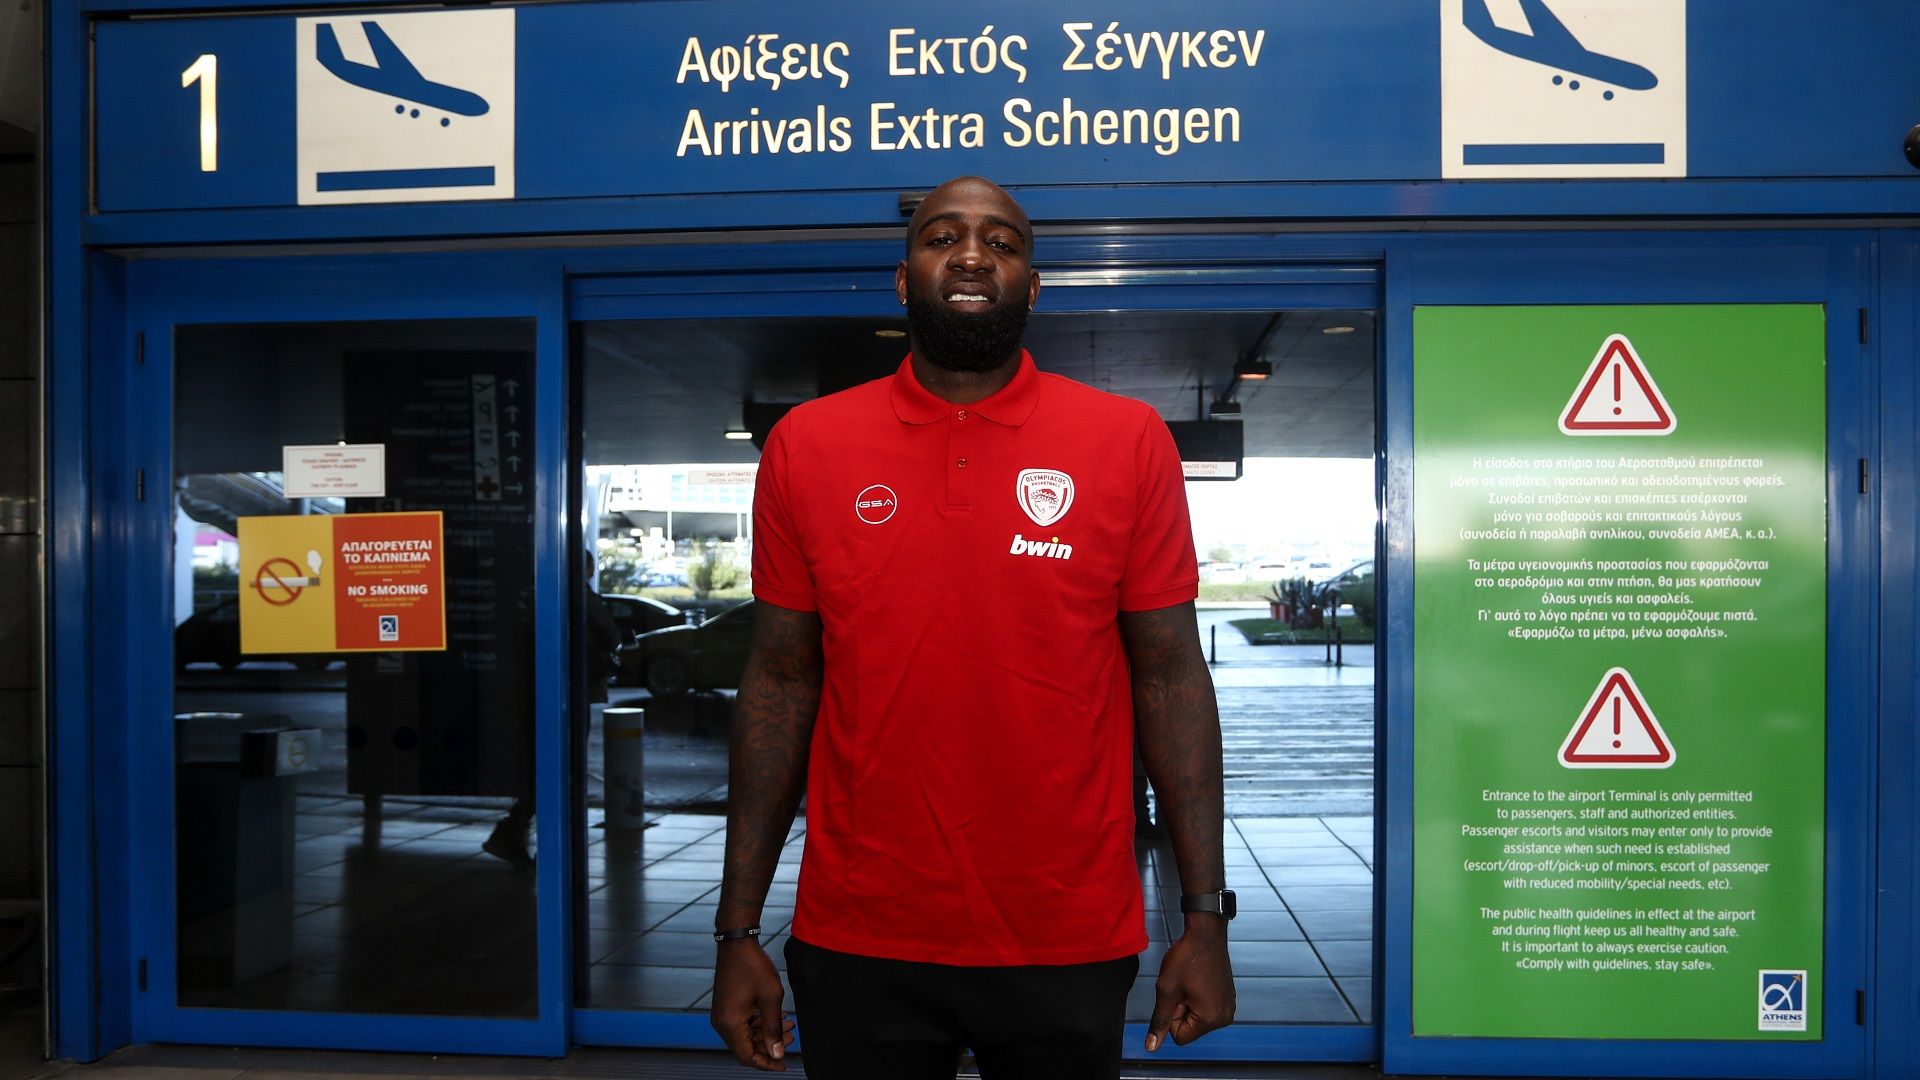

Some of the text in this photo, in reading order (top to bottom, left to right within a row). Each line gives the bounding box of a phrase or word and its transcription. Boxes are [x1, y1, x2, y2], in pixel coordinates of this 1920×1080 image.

[676, 22, 1266, 92] Αφίξεις Εκτός Σένγκεν
[181, 53, 217, 172] 1
[676, 98, 1241, 156] Arrivals Extra Schengen
[1025, 475, 1066, 485] OLYMPIACOS
[859, 498, 894, 509] GSA
[1489, 492, 1747, 506] Συνοδοί επιβατών και επισκέπτες εισέρχονται
[1494, 510, 1742, 524] μόνο για σοβαρούς και επιτακτικούς λόγους
[1460, 528, 1516, 539] (συνοδεία
[1520, 528, 1526, 539] ή
[1530, 528, 1586, 541] παραλαβή
[1590, 528, 1645, 539] ανηλίκου,
[1649, 528, 1701, 539] συνοδεία
[1705, 528, 1742, 539] ΑΜΕΑ,
[341, 540, 433, 552] ΑΠΑΓΟΡΕΥΕΤΑΙ
[1009, 534, 1073, 560] bwin
[343, 551, 431, 563] ΤΟ ΚΑΠΝΙΣΜΑ
[1468, 559, 1768, 572] Τα μέτρα υγειονομικής προστασίας που εφαρμόζονται
[1475, 575, 1761, 589] στο αεροδρόμιο και στην πτήση, θα μας κρατήσουν
[347, 584, 429, 596] NO SMOKING
[1542, 592, 1693, 606] όλους υγιείς και ασφαλείς.
[1495, 609, 1521, 621] αυτό
[1524, 612, 1536, 621] το
[1540, 609, 1567, 623] λόγο
[1571, 609, 1607, 622] πρέπει
[1611, 612, 1625, 621] να
[1628, 612, 1640, 621] τα
[1644, 609, 1720, 623] εφαρμόζουμε
[1724, 609, 1757, 620] πιστά.
[1578, 629, 1590, 638] τα
[1593, 626, 1628, 640] μέτρα,
[1632, 626, 1662, 640] μένω
[1483, 790, 1752, 803] Entrance to the airport Terminal is only permitted
[1497, 808, 1736, 821] to passengers, staff and authorized entities.
[1462, 825, 1773, 839] Passenger escorts and visitors may enter only to provide
[1504, 843, 1730, 854] assistance when such need is established
[1464, 859, 1770, 874] (escort/drop-off/pick-up of minors, escort of passenger
[1504, 877, 1732, 891] with reduced mobility/special needs, etc).
[1480, 907, 1755, 922] The public health guidelines in effect at the airport
[1492, 925, 1739, 938] and during flight keep us all healthy and safe.
[1502, 941, 1728, 954] It is important to always exercise caution.
[1567, 958, 1590, 969] with
[1593, 959, 1651, 971] guidelines,
[1655, 959, 1679, 972] stay
[1762, 1013, 1803, 1021] ATHENS
